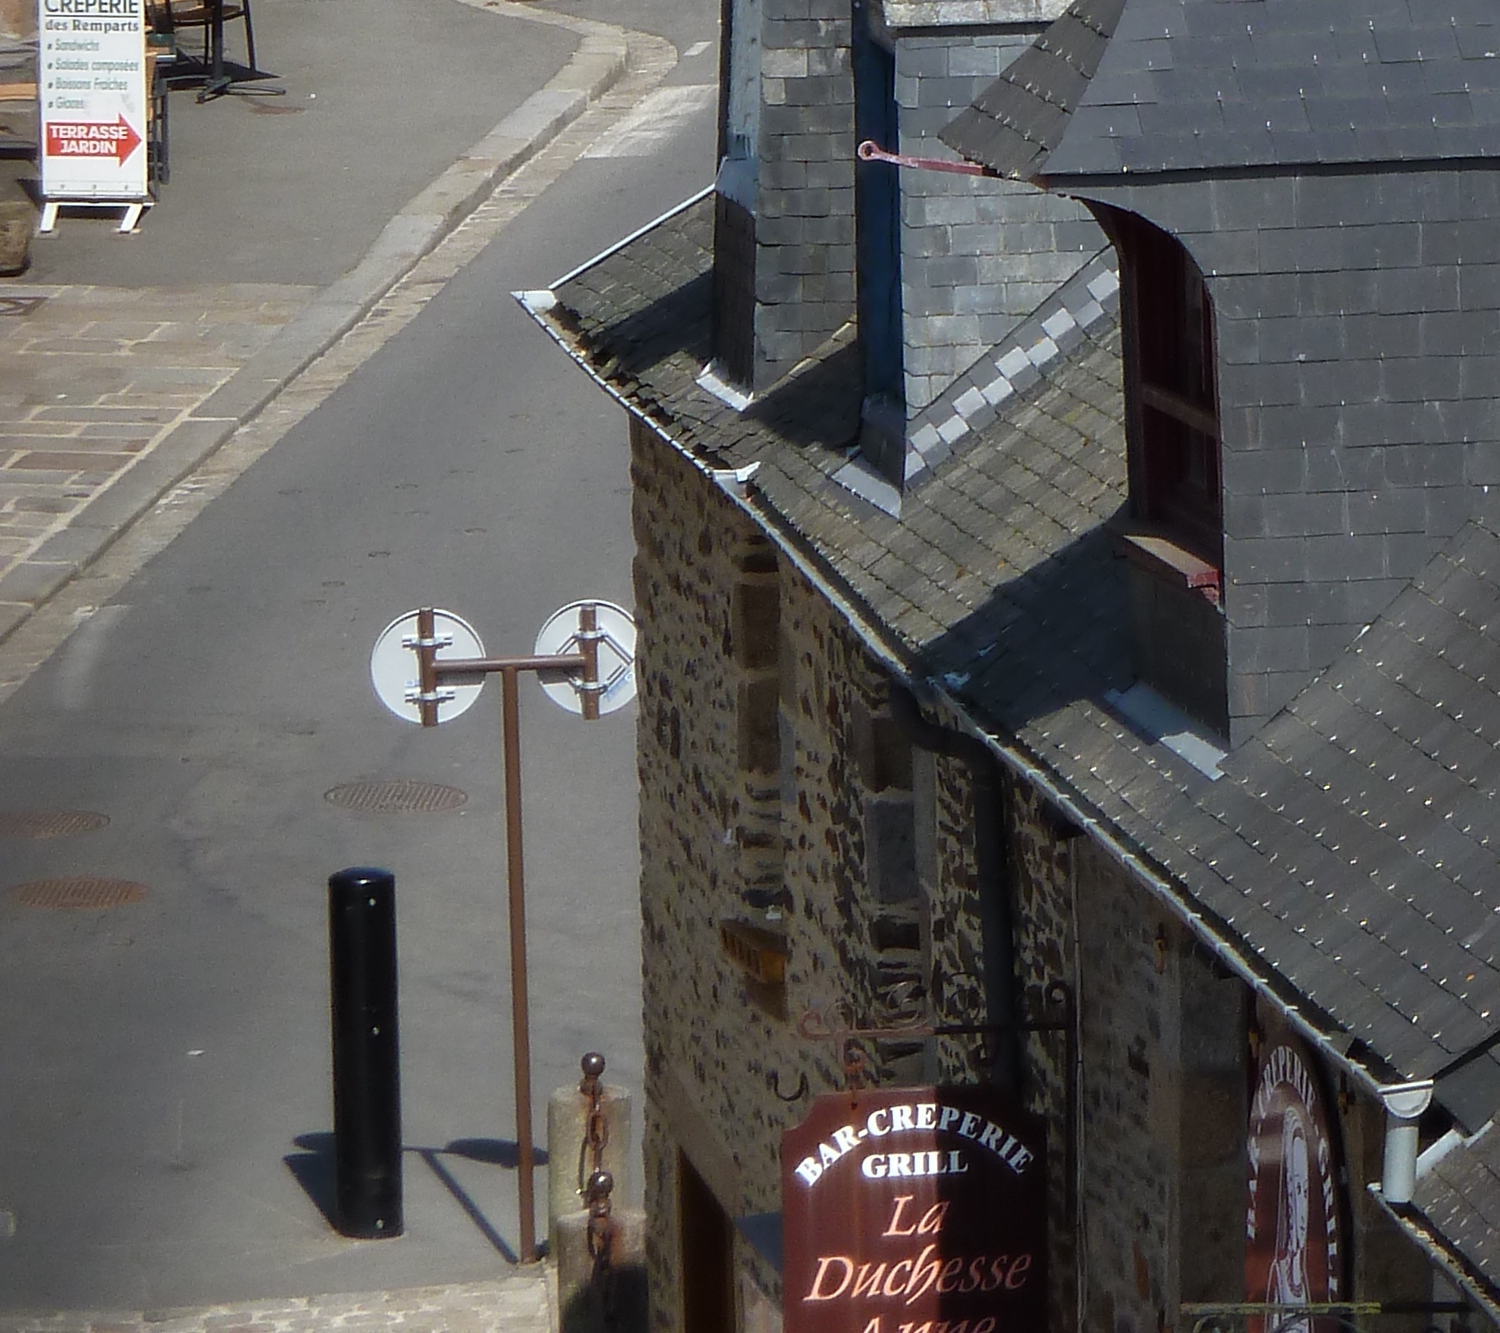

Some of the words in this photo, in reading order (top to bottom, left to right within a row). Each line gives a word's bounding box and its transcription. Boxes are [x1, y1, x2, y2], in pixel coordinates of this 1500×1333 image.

[45, 19, 68, 31] des
[72, 19, 139, 34] Remparts
[55, 58, 89, 71] Salades
[55, 77, 91, 90] Boissons
[50, 125, 128, 140] TERRASSE
[60, 140, 117, 153] JARDIN
[795, 1102, 1035, 1186] BAR-CREPERIE
[861, 1150, 969, 1179] GRILL
[882, 1195, 951, 1237] La
[803, 1244, 1032, 1305] Duchesse
